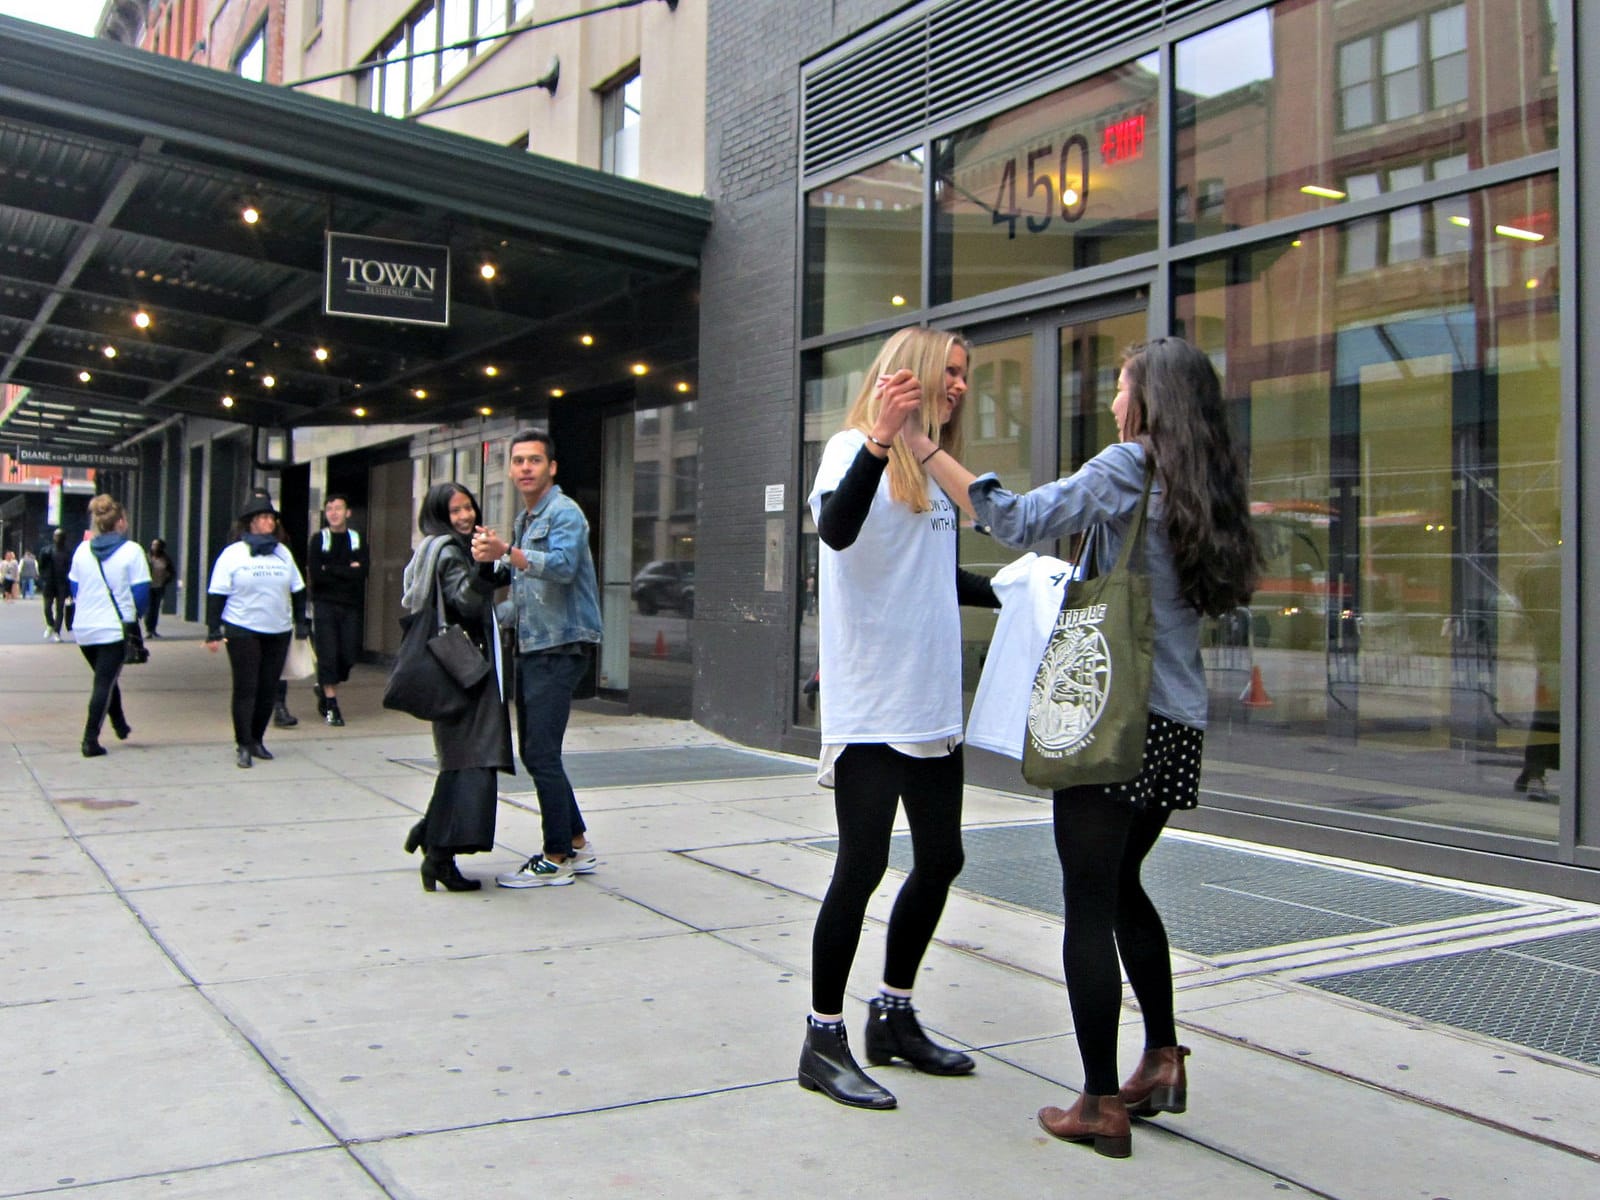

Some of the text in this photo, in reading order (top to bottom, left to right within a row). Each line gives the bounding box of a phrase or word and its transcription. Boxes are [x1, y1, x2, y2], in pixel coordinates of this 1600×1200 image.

[992, 133, 1090, 239] 450
[341, 256, 437, 290] TOWN
[20, 450, 51, 460] DIANE
[930, 517, 950, 531] WITH
[1056, 603, 1108, 628] TITUDE
